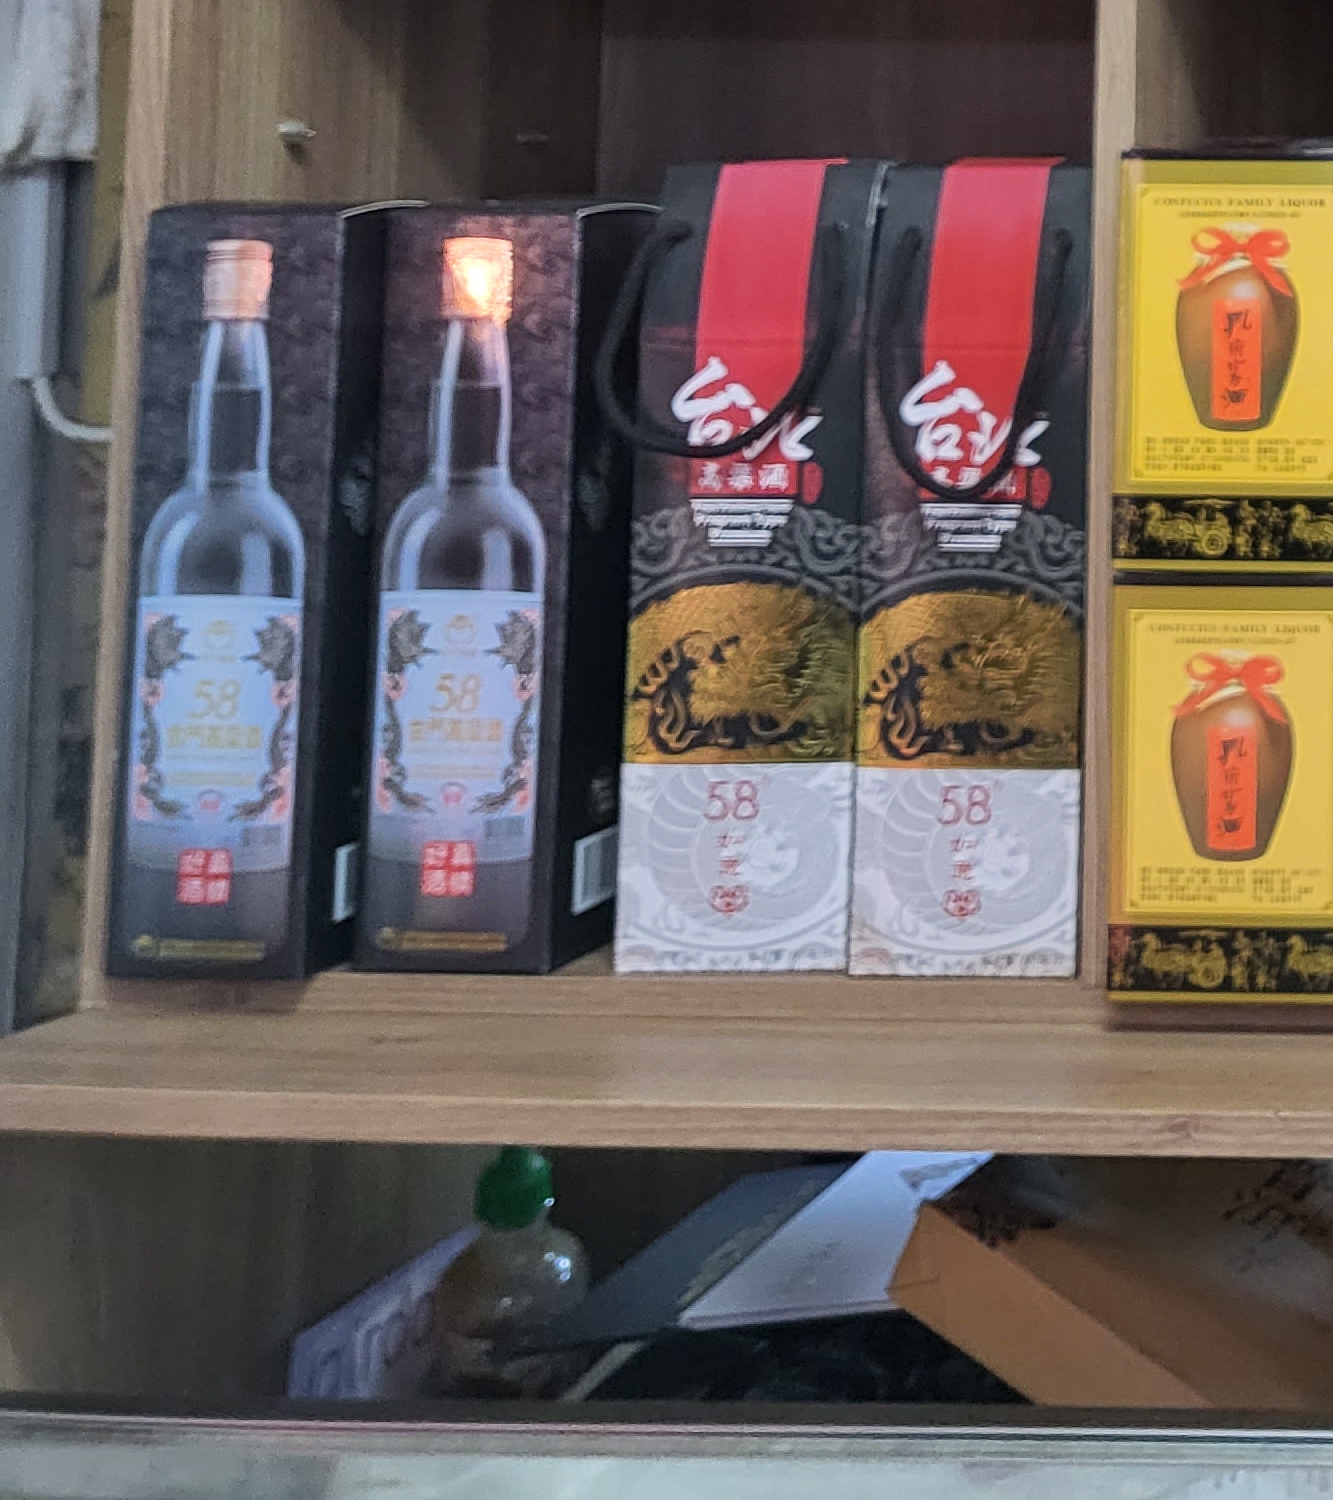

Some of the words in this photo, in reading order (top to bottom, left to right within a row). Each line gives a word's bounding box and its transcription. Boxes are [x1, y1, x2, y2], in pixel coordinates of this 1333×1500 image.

[1152, 196, 1224, 208] CONFUCIUS
[1227, 197, 1275, 208] FAMILY
[1279, 197, 1327, 209] LIQUOR
[187, 678, 243, 722] 58
[428, 671, 482, 714] 58
